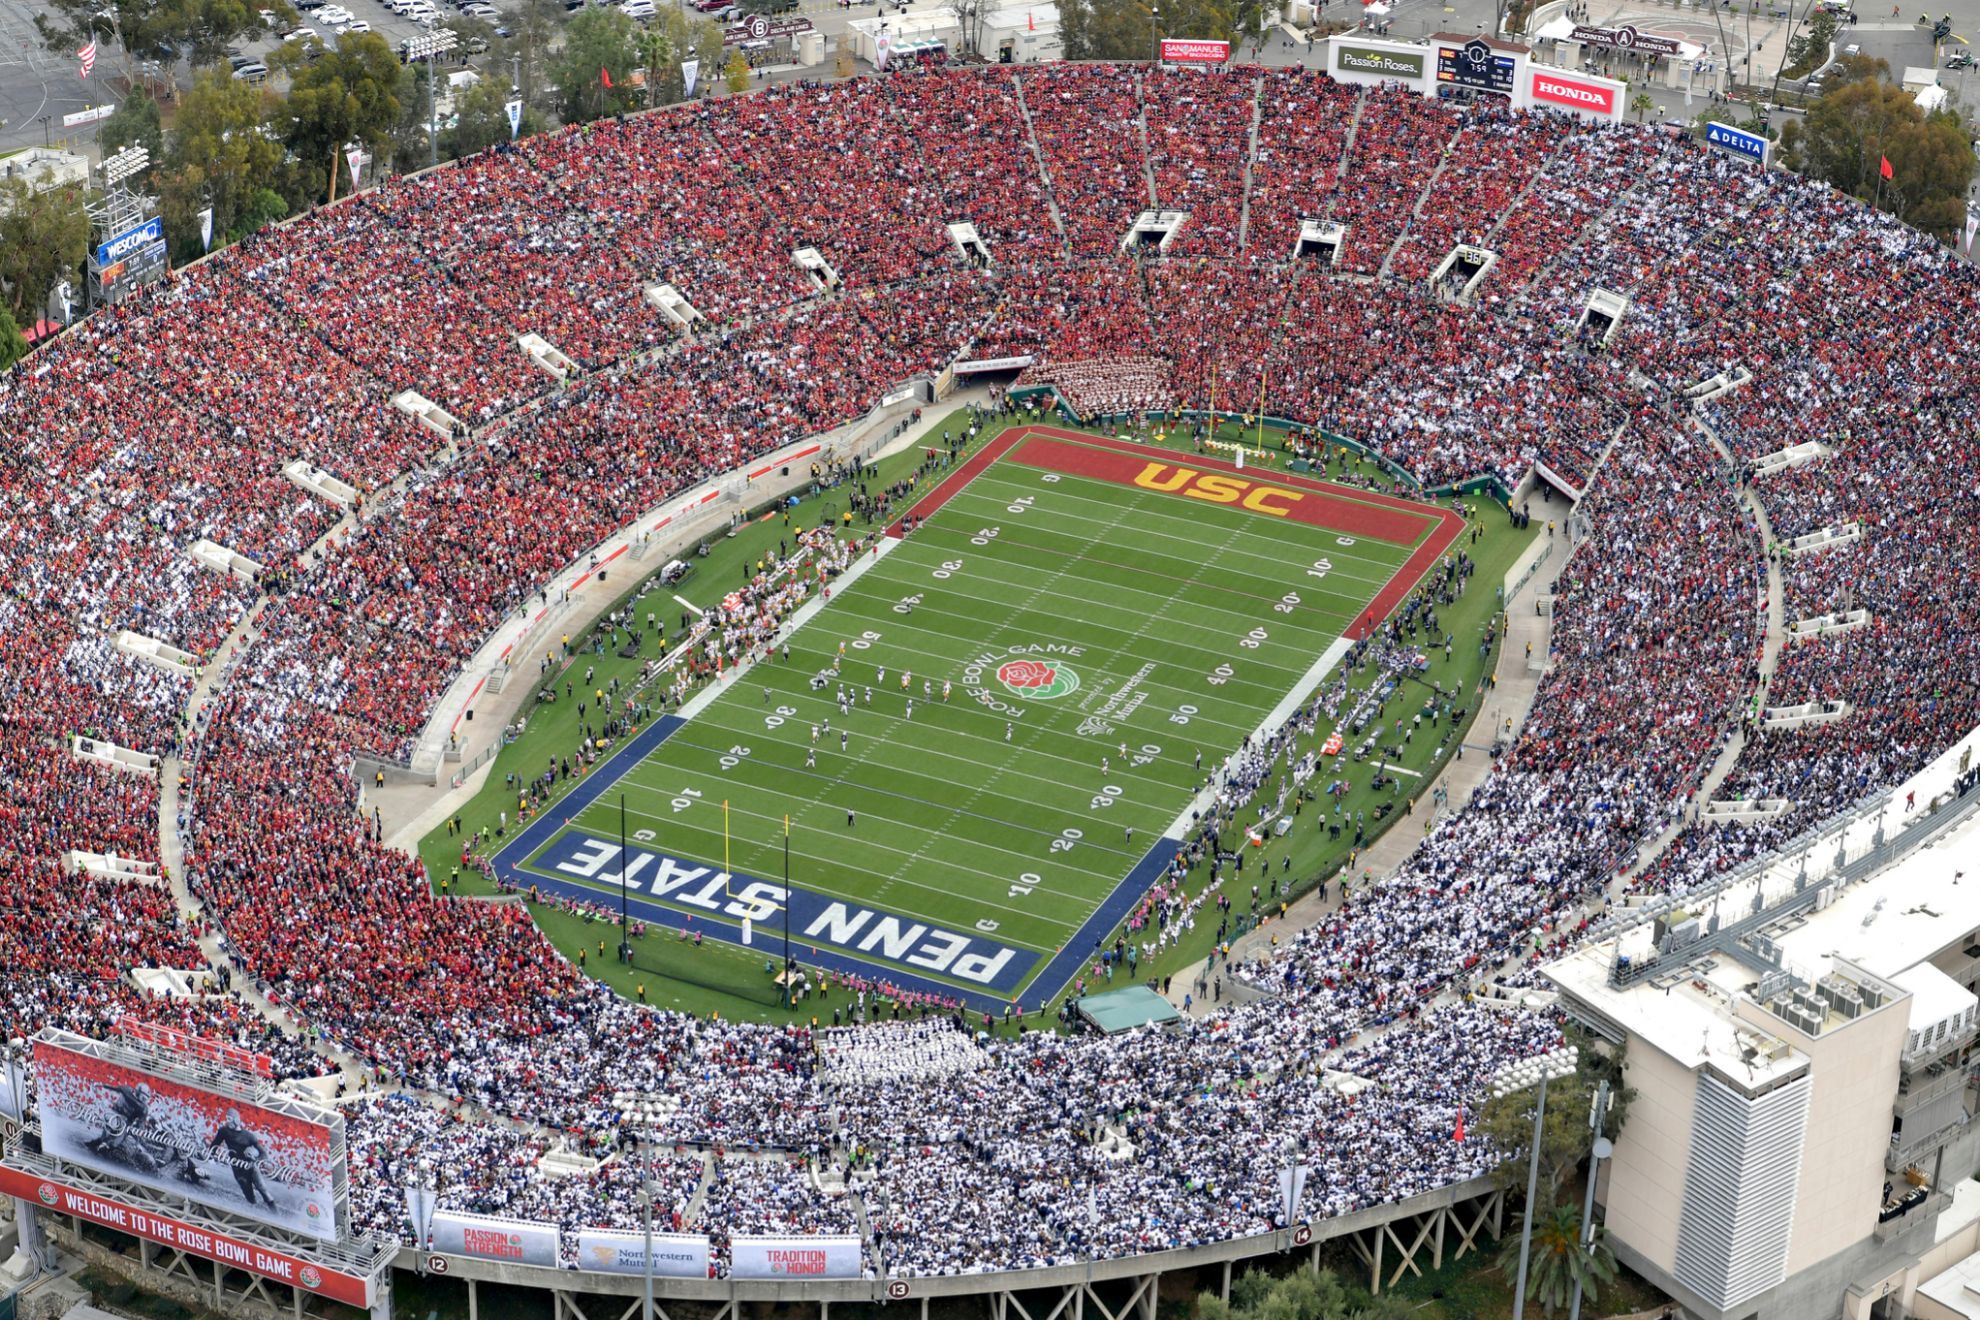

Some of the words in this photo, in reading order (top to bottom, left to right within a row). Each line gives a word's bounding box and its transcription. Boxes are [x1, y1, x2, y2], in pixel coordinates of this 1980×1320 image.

[755, 22, 765, 35] B
[1574, 31, 1612, 43] HONDA
[1619, 31, 1628, 45] A
[1165, 44, 1183, 52] SAN
[1189, 45, 1224, 53] MANUEL
[1635, 41, 1673, 53] HONDA
[1538, 81, 1606, 105] HONDA
[1722, 132, 1760, 154] DELTA
[107, 229, 147, 259] WESCOM
[1467, 251, 1480, 263] 36
[1134, 462, 1305, 516] USC
[1007, 496, 1034, 513] 10
[971, 527, 998, 545] 20
[932, 560, 961, 579] 30
[1307, 559, 1332, 578] 10
[1273, 594, 1301, 614] 20
[851, 631, 882, 649] 50
[1239, 629, 1268, 649] 30
[962, 652, 1008, 685] BOWL
[1008, 643, 1087, 657] GAME
[1207, 665, 1234, 686] 40
[1094, 662, 1157, 717] Northwestern
[764, 705, 797, 726] 30
[1111, 690, 1150, 721] Mutual
[1169, 704, 1199, 725] 50
[719, 745, 751, 767] 20
[1133, 744, 1162, 766] 40
[671, 787, 703, 808] 10
[1094, 785, 1123, 807] 30
[1053, 828, 1083, 851] 20
[556, 838, 792, 922] STATE
[1011, 872, 1041, 895] 10
[803, 901, 1016, 984] PENN
[66, 1101, 101, 1124] The
[104, 1113, 197, 1158] Granddaddy
[65, 1192, 127, 1225] WELCOME
[131, 1211, 147, 1233] TO
[149, 1218, 175, 1241] THE
[177, 1229, 212, 1253] ROSE
[215, 1240, 253, 1266] BOWL
[256, 1255, 293, 1279] GAME
[464, 1228, 508, 1244] PASSION
[1297, 1230, 1309, 1242] 14
[464, 1240, 523, 1260] STRENGTH
[619, 1249, 693, 1261] Nortwestern
[767, 1250, 826, 1263] TRADITION
[430, 1259, 446, 1271] 12
[618, 1258, 657, 1268] Mutul
[786, 1262, 826, 1274] HONOR
[892, 1284, 907, 1296] 13
